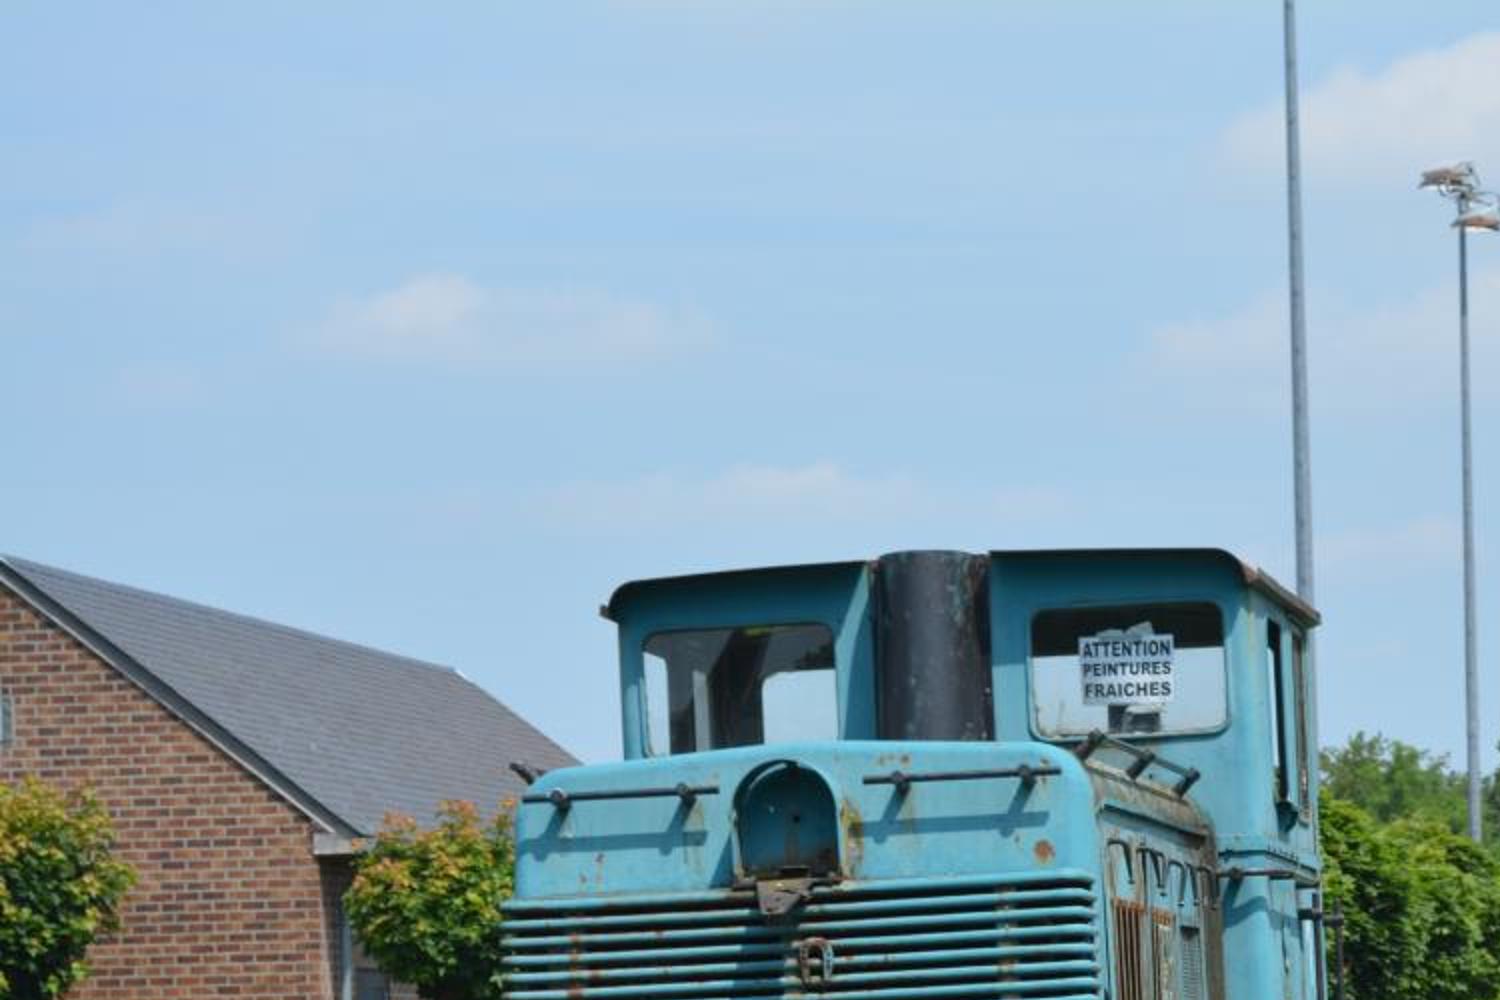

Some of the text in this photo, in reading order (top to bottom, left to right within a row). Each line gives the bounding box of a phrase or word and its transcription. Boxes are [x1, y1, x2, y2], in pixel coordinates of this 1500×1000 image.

[1083, 640, 1170, 658] ATTENTION
[1083, 661, 1171, 677] PEINTURES
[1084, 682, 1171, 698] FRAICHES
